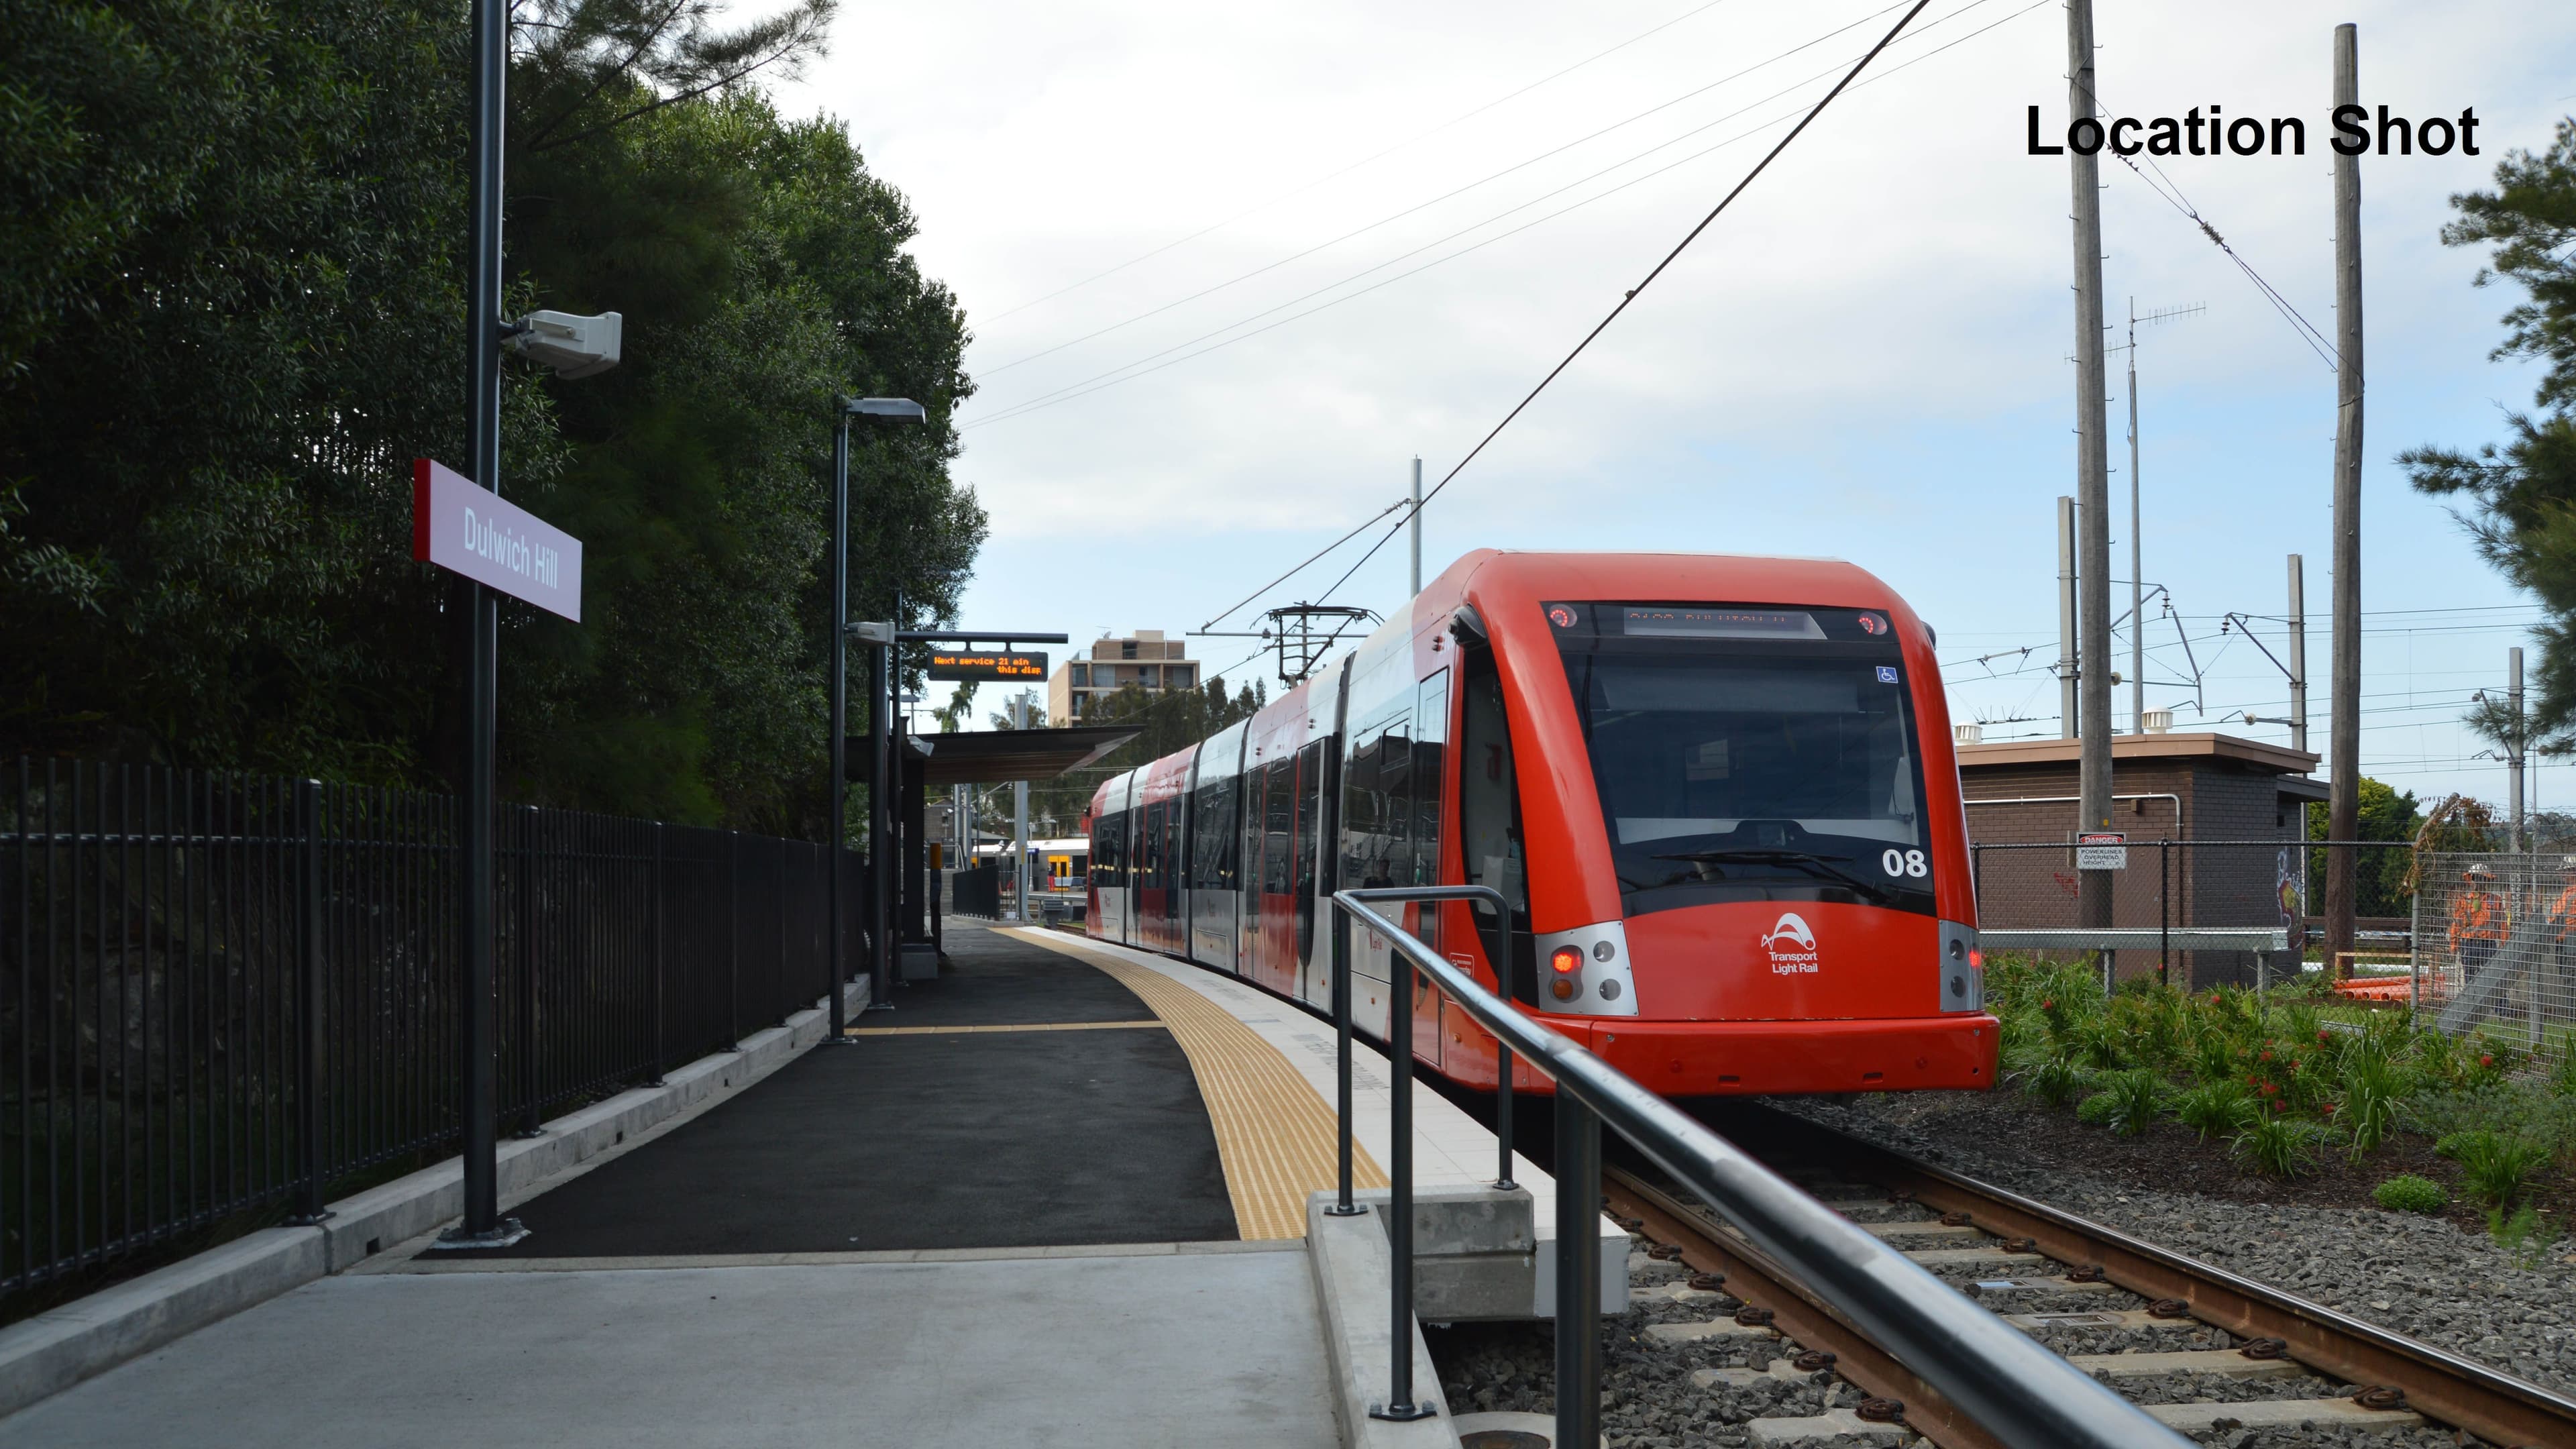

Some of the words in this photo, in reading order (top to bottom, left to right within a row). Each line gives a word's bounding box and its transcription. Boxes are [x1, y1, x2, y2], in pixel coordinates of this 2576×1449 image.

[464, 506, 530, 577] Dulwich
[535, 543, 558, 589] Hill
[934, 656, 956, 665] Next
[959, 657, 996, 665] service
[998, 657, 1009, 665] 21
[996, 665, 1018, 674] this
[1882, 849, 1928, 878] 08
[1768, 951, 1818, 963] Transport
[1772, 963, 1798, 975] Light
[1799, 963, 1819, 973] Rail
